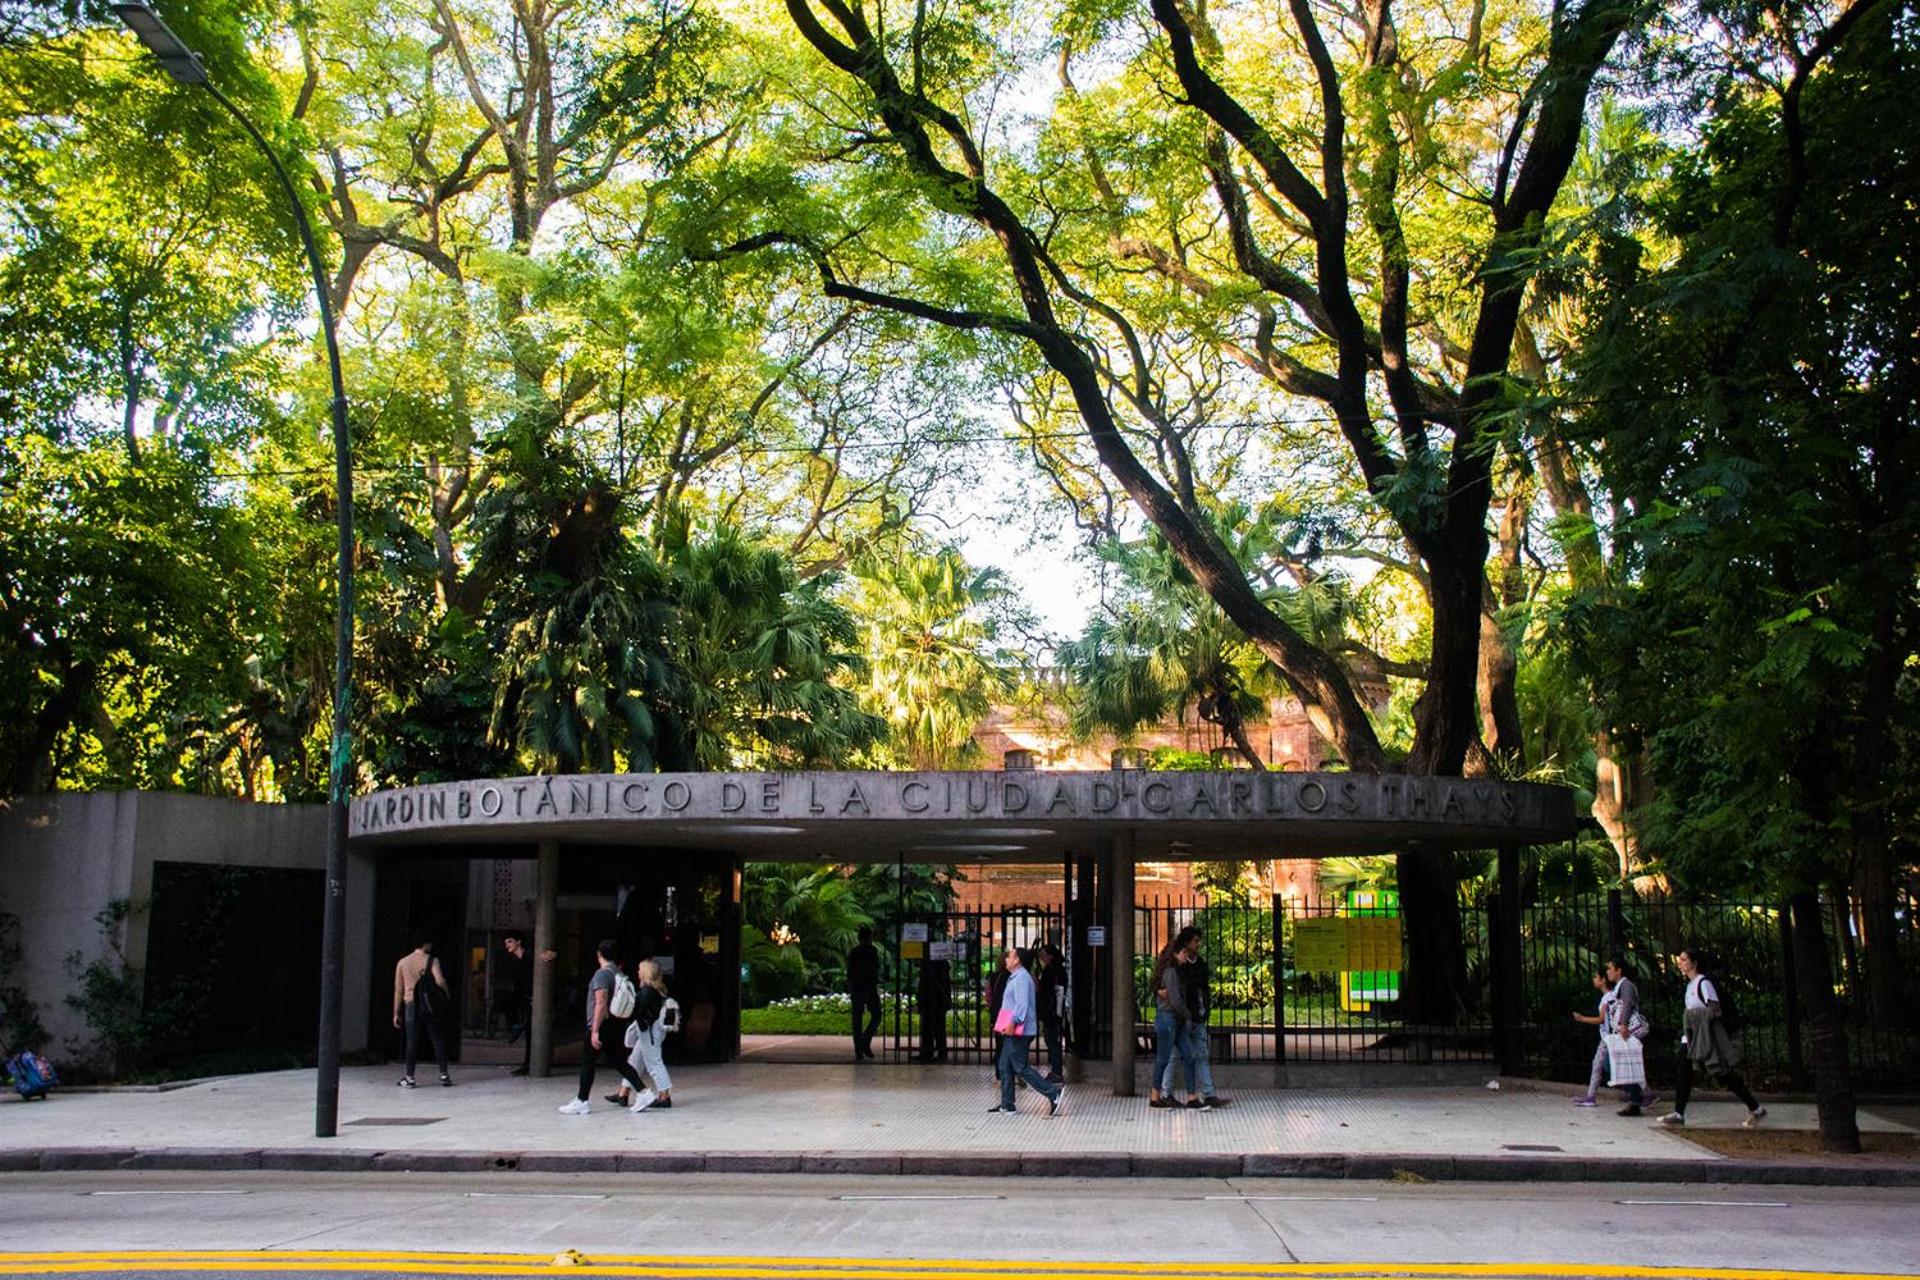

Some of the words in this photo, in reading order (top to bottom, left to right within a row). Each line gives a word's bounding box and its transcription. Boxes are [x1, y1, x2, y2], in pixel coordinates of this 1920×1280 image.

[361, 791, 446, 830] JARDIN
[720, 779, 780, 813] DE
[808, 779, 871, 813] LA
[1382, 783, 1519, 825] THAYS
